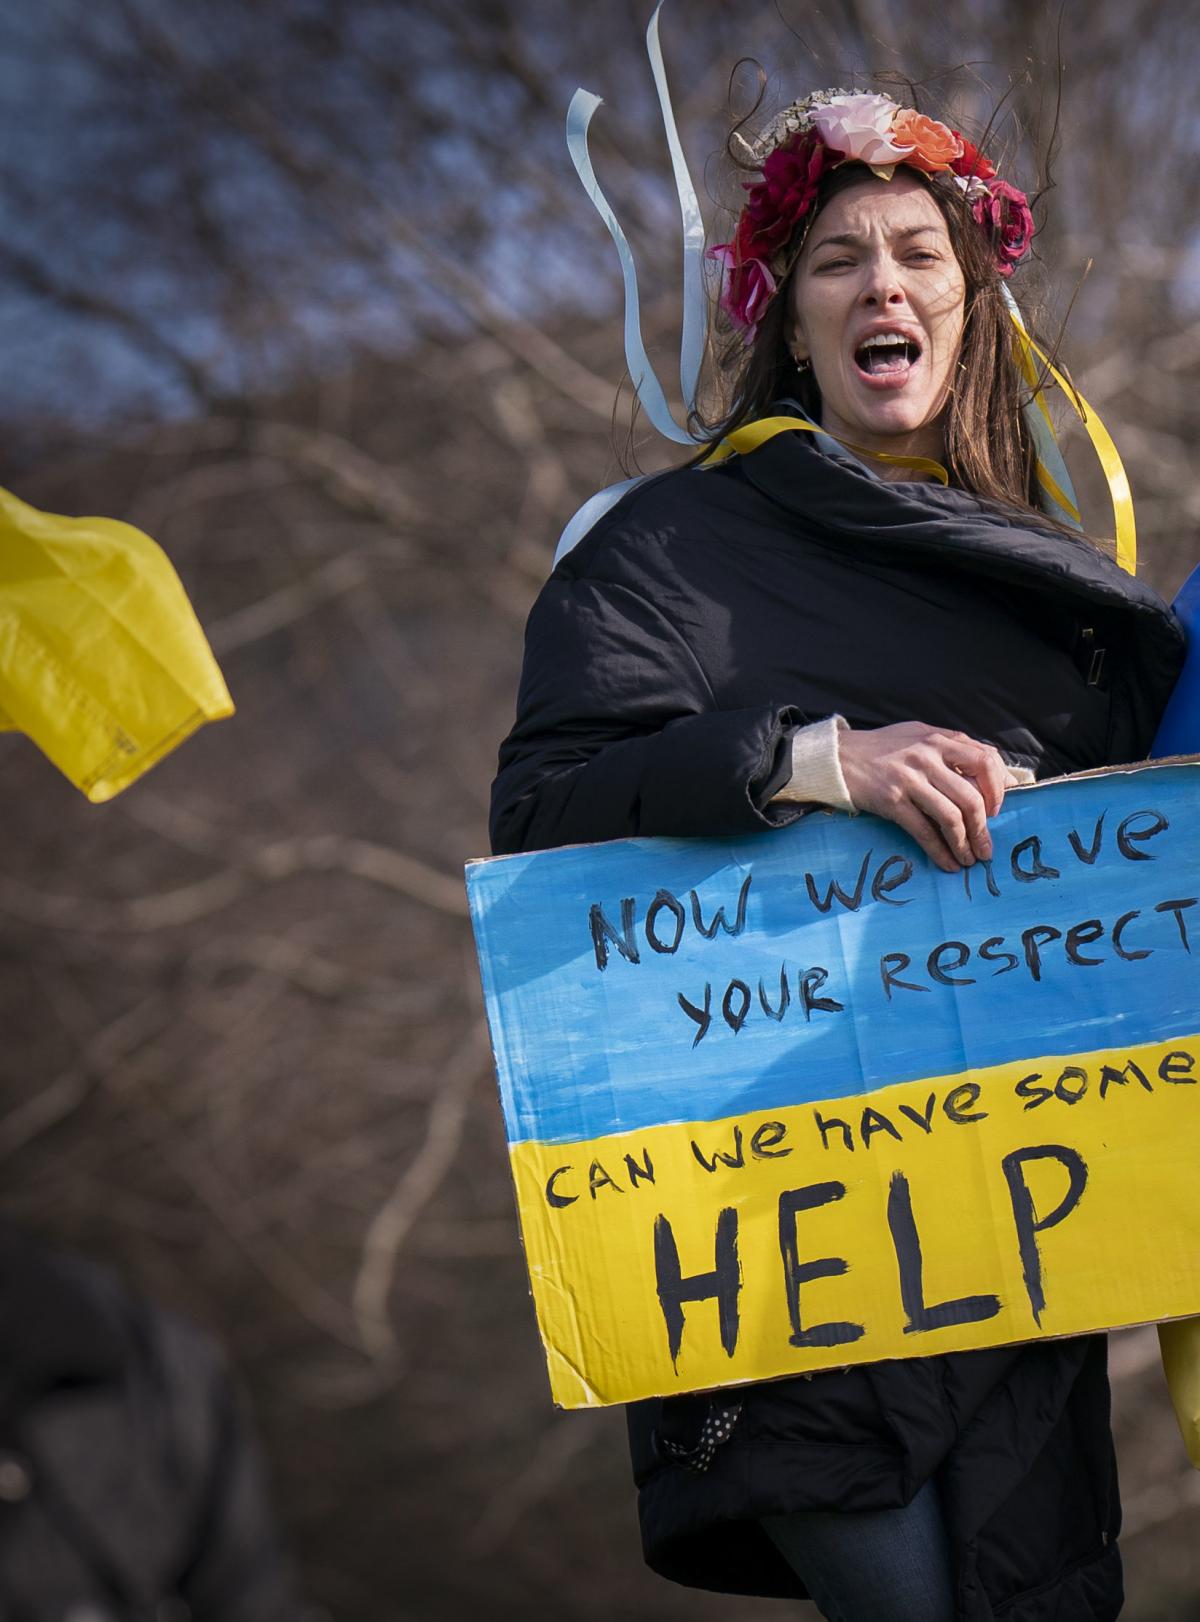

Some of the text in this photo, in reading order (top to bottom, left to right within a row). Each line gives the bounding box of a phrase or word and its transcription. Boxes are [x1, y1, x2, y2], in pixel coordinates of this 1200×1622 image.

[588, 873, 753, 972] NOW
[546, 1146, 657, 1209] CAN
[652, 1143, 1089, 1377] HELP
